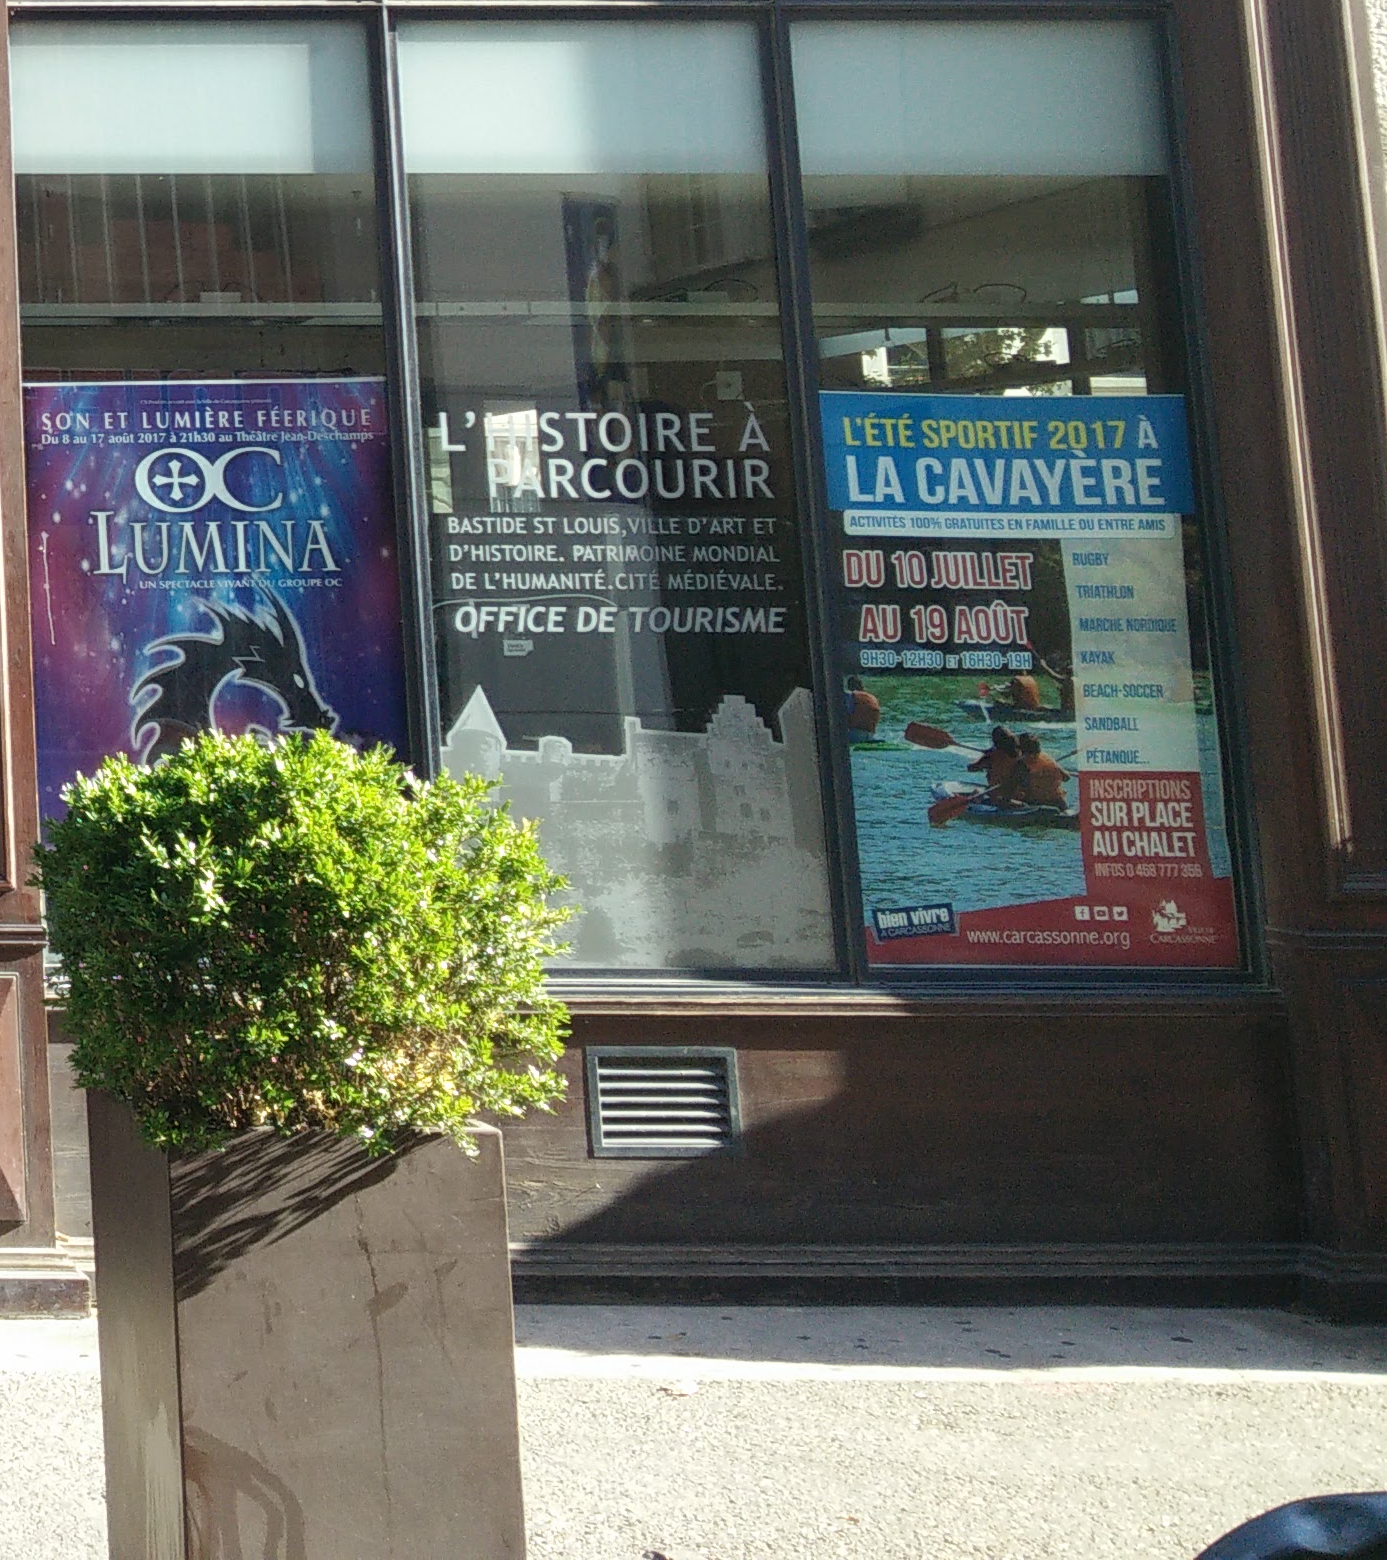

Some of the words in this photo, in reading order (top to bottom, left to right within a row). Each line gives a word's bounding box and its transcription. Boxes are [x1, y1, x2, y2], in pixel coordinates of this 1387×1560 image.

[41, 411, 89, 431] SON
[104, 411, 128, 429] ET
[142, 405, 244, 429] LUMIÈRE
[258, 404, 372, 430] FÉERIQUE
[739, 402, 771, 452] À
[41, 433, 59, 445] Du
[62, 433, 70, 444] 8
[72, 435, 88, 444] au
[91, 433, 105, 444] 17
[107, 432, 135, 444] août
[136, 432, 167, 444] 2017
[170, 432, 178, 443] à
[180, 431, 216, 443] 21h30
[219, 433, 233, 443] au
[235, 431, 278, 443] Théâtre
[280, 431, 374, 444] Jean-Deschamps
[843, 412, 916, 449] L'ÉTÉ
[922, 419, 1038, 450] SPORTIF
[1047, 420, 1125, 450] 2017
[1137, 414, 1159, 450] À
[135, 446, 283, 513] OC
[488, 457, 775, 500] PARCOURIR
[845, 455, 906, 503] LA
[916, 449, 1165, 506] CAVAYÈRE
[447, 517, 527, 535] BASTIDE
[533, 517, 556, 534] ST
[688, 517, 746, 535] D'ART
[753, 517, 776, 534] ET
[849, 513, 906, 529] ACTIVITÉS
[910, 516, 942, 530] 100%
[944, 516, 1005, 531] GRATUITES
[1007, 518, 1023, 531] EN
[1026, 518, 1077, 531] FAMILLE
[1079, 518, 1095, 531] OU
[1097, 518, 1136, 532] ENTRE
[1137, 519, 1166, 532] AMIS
[90, 510, 342, 584] LUMINA
[449, 544, 565, 563] D'HISTOIRE.
[572, 544, 687, 563] PATRIMOINE
[692, 544, 781, 563] MONDIAL
[1072, 552, 1109, 567] RUGBY
[451, 572, 477, 590] DE
[615, 568, 661, 590] CITÉ
[668, 567, 785, 591] MÉDIÉVALE.
[843, 550, 885, 588] DU
[891, 551, 927, 588] 10
[931, 552, 1033, 590] JUILLET
[139, 578, 157, 589] UN
[159, 578, 216, 590] SPECTACLE
[217, 578, 258, 589] VIVANT
[259, 578, 276, 589] DU
[278, 578, 323, 588] GROUPE
[325, 577, 343, 588] OC
[1076, 585, 1134, 600] TRIATHLON
[454, 604, 566, 634] OFFICE
[578, 606, 617, 633] DE
[629, 606, 787, 634] TOURISME
[859, 604, 902, 643] AU
[910, 604, 949, 644] 19
[955, 599, 1029, 645] AOÛT
[1079, 618, 1124, 633] MARCHE
[1126, 618, 1178, 633] NORDIQUE
[859, 650, 944, 669] 9H30-12H30
[946, 655, 959, 668] ET
[960, 651, 1033, 670] 16H30-19H
[1080, 651, 1116, 665] KAYAK
[1082, 683, 1164, 699] BEACH-SOCCER
[1084, 717, 1140, 732] SANDBALL
[1089, 779, 1192, 800] INSCRIPTIONS
[1091, 802, 1129, 827] SUR
[1131, 802, 1194, 828] PLACE
[1092, 832, 1119, 857] AU
[1122, 831, 1197, 858] CHALET
[1095, 863, 1125, 877] INFOS
[877, 909, 910, 929] bien
[912, 905, 950, 927] vivre
[890, 923, 952, 937] CARCASSONNE
[967, 929, 1130, 949] www.carcassonne.org
